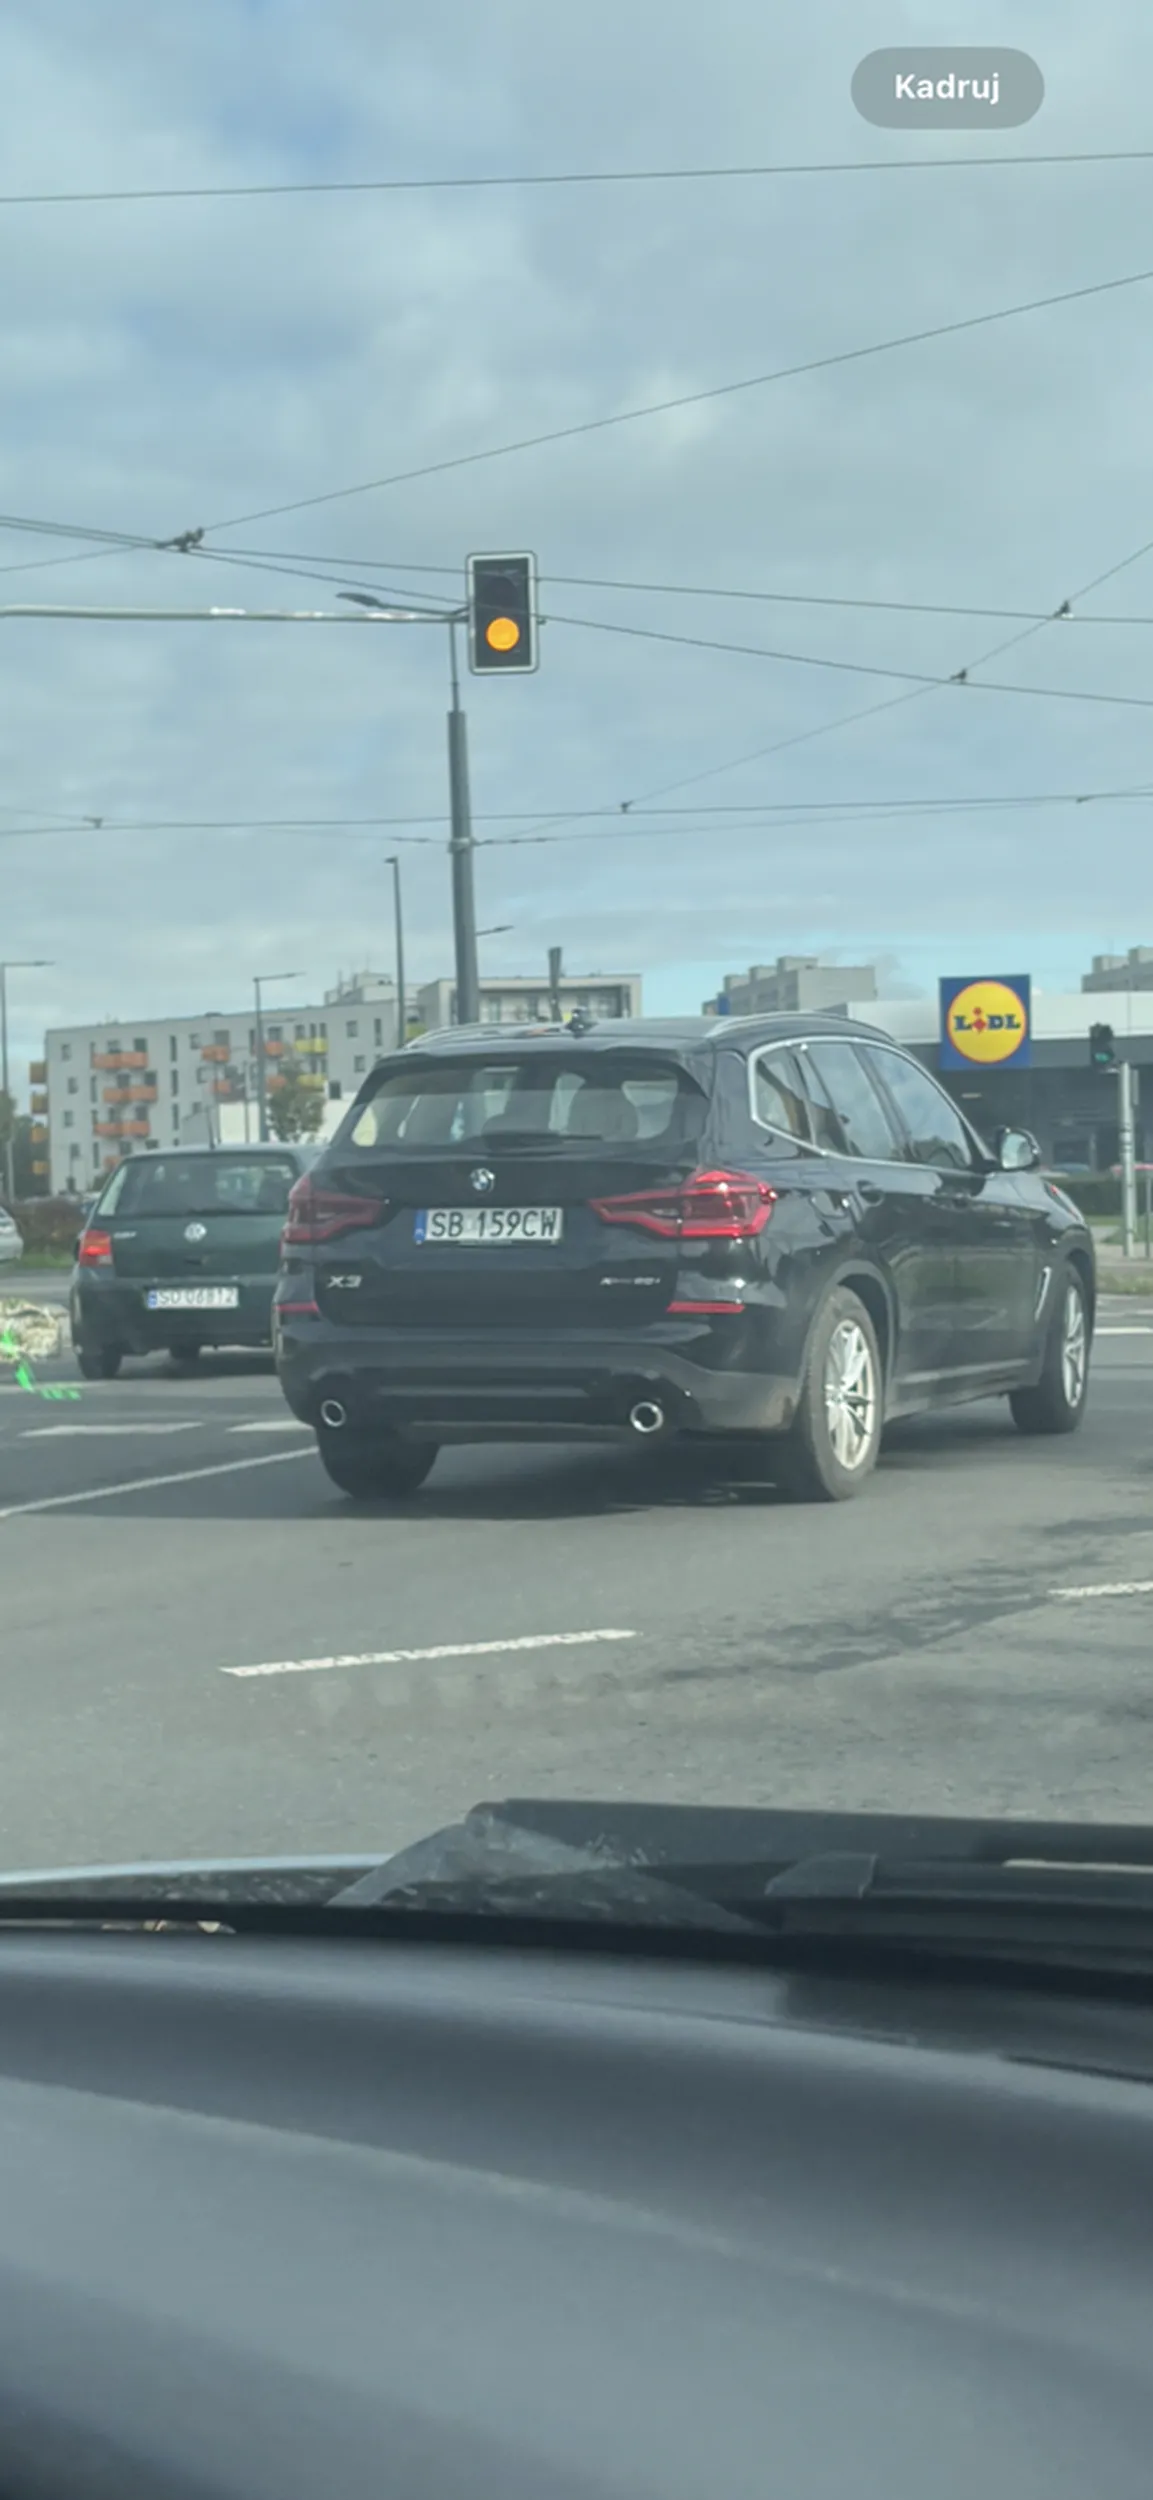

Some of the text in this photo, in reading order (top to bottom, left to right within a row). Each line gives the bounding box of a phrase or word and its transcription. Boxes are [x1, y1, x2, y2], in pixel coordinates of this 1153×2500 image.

[431, 1209, 557, 1237] SB 159CW
[327, 1274, 362, 1288] X3
